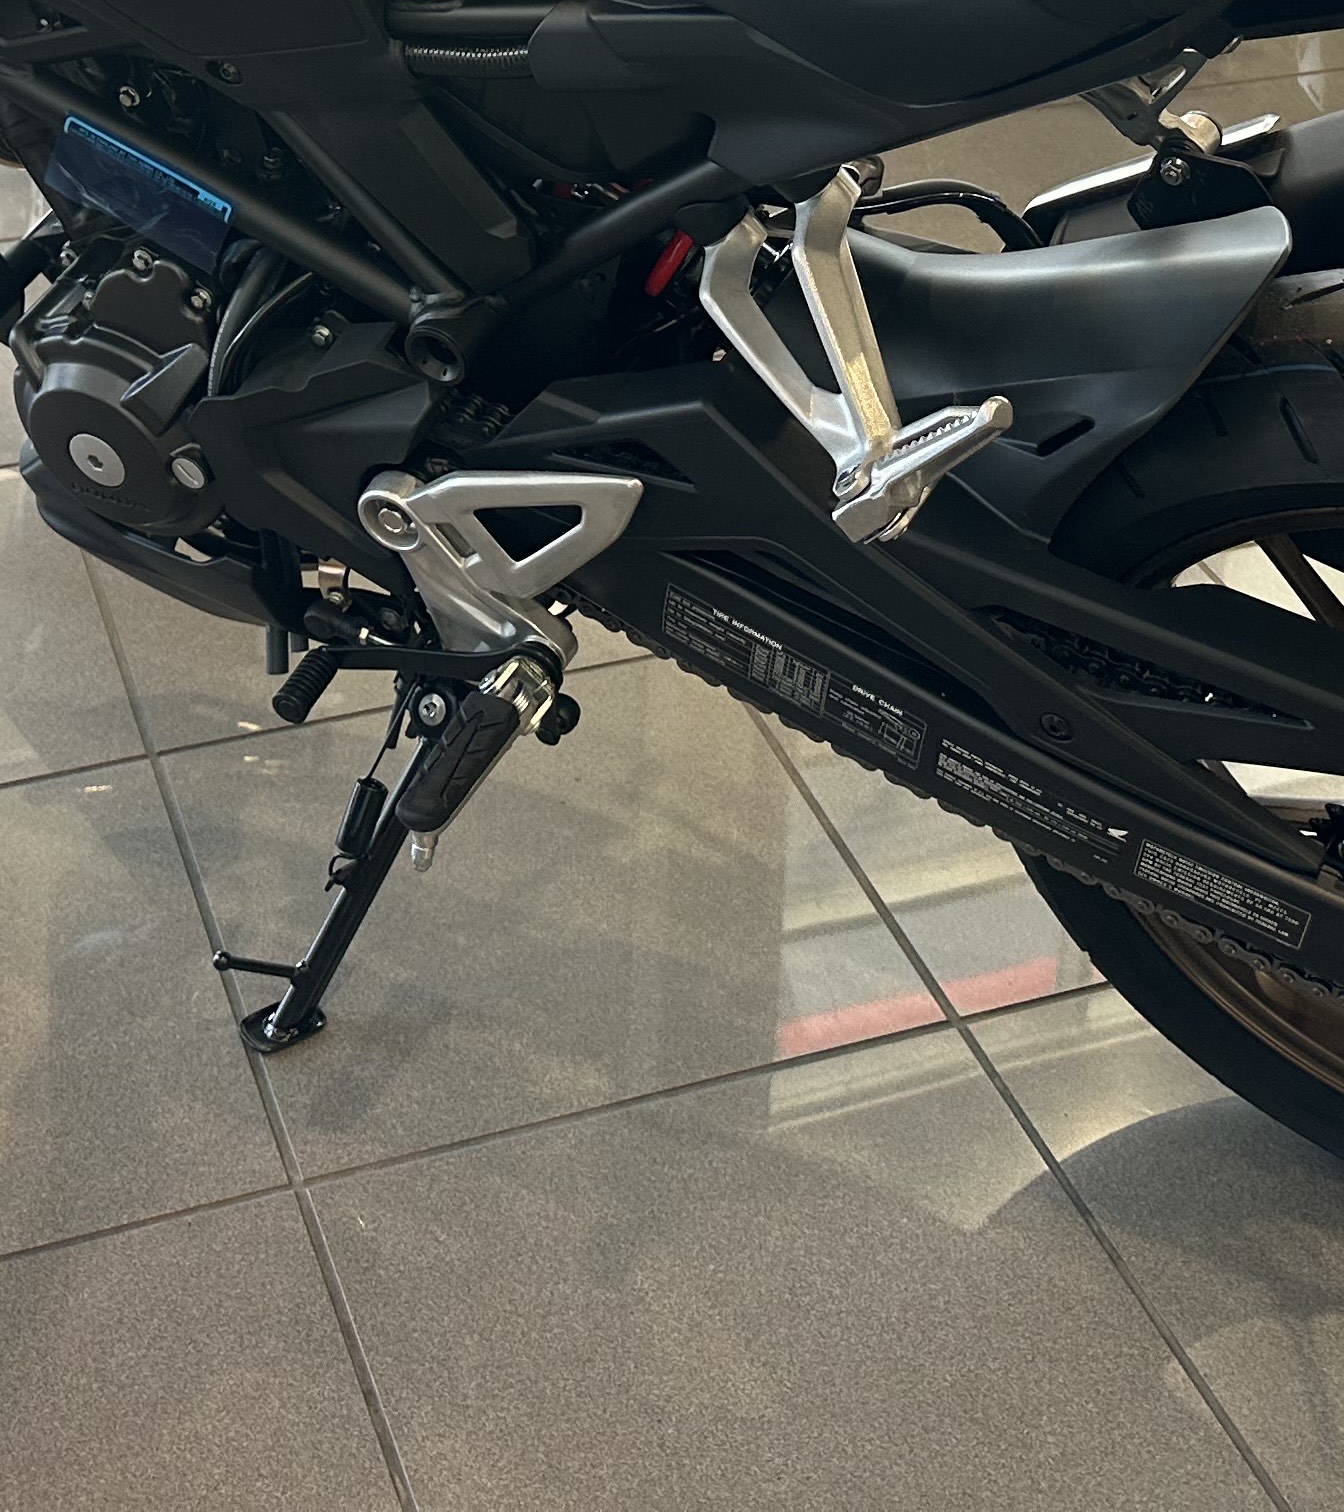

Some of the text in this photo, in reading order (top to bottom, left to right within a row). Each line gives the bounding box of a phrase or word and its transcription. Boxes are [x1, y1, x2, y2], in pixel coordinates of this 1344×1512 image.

[732, 620, 783, 651] INFORMATION
[852, 684, 903, 717] DRIVE CHAIN
